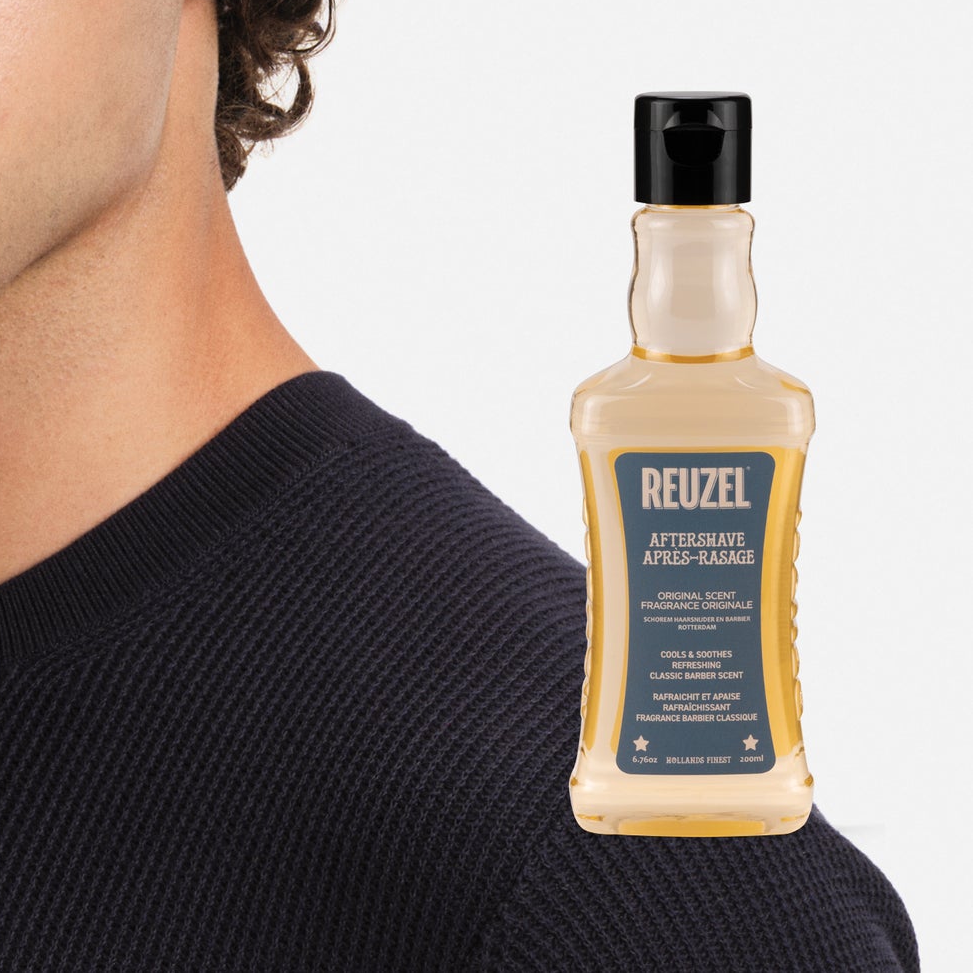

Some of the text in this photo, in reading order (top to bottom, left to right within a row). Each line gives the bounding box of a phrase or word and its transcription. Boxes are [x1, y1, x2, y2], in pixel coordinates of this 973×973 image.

[641, 467, 751, 510] REUZEL
[649, 532, 745, 548] AFTERSHAVE
[643, 548, 755, 565] APRÈS-RASAGE
[658, 591, 736, 600] ORIGINAL SCENT
[641, 601, 753, 610] FRAGRANCE ORIGINALE
[660, 651, 686, 659] COOLS
[696, 650, 732, 658] SOOTHES
[672, 661, 721, 669] REFRESHING
[650, 672, 683, 680] CLASSIC
[663, 702, 730, 711] RAFRAÎCHISSANT
[636, 713, 757, 722] FRAGRANCE BARBIER CLASSIQUE
[707, 756, 731, 764] FINEST
[740, 755, 763, 763] 200ml
